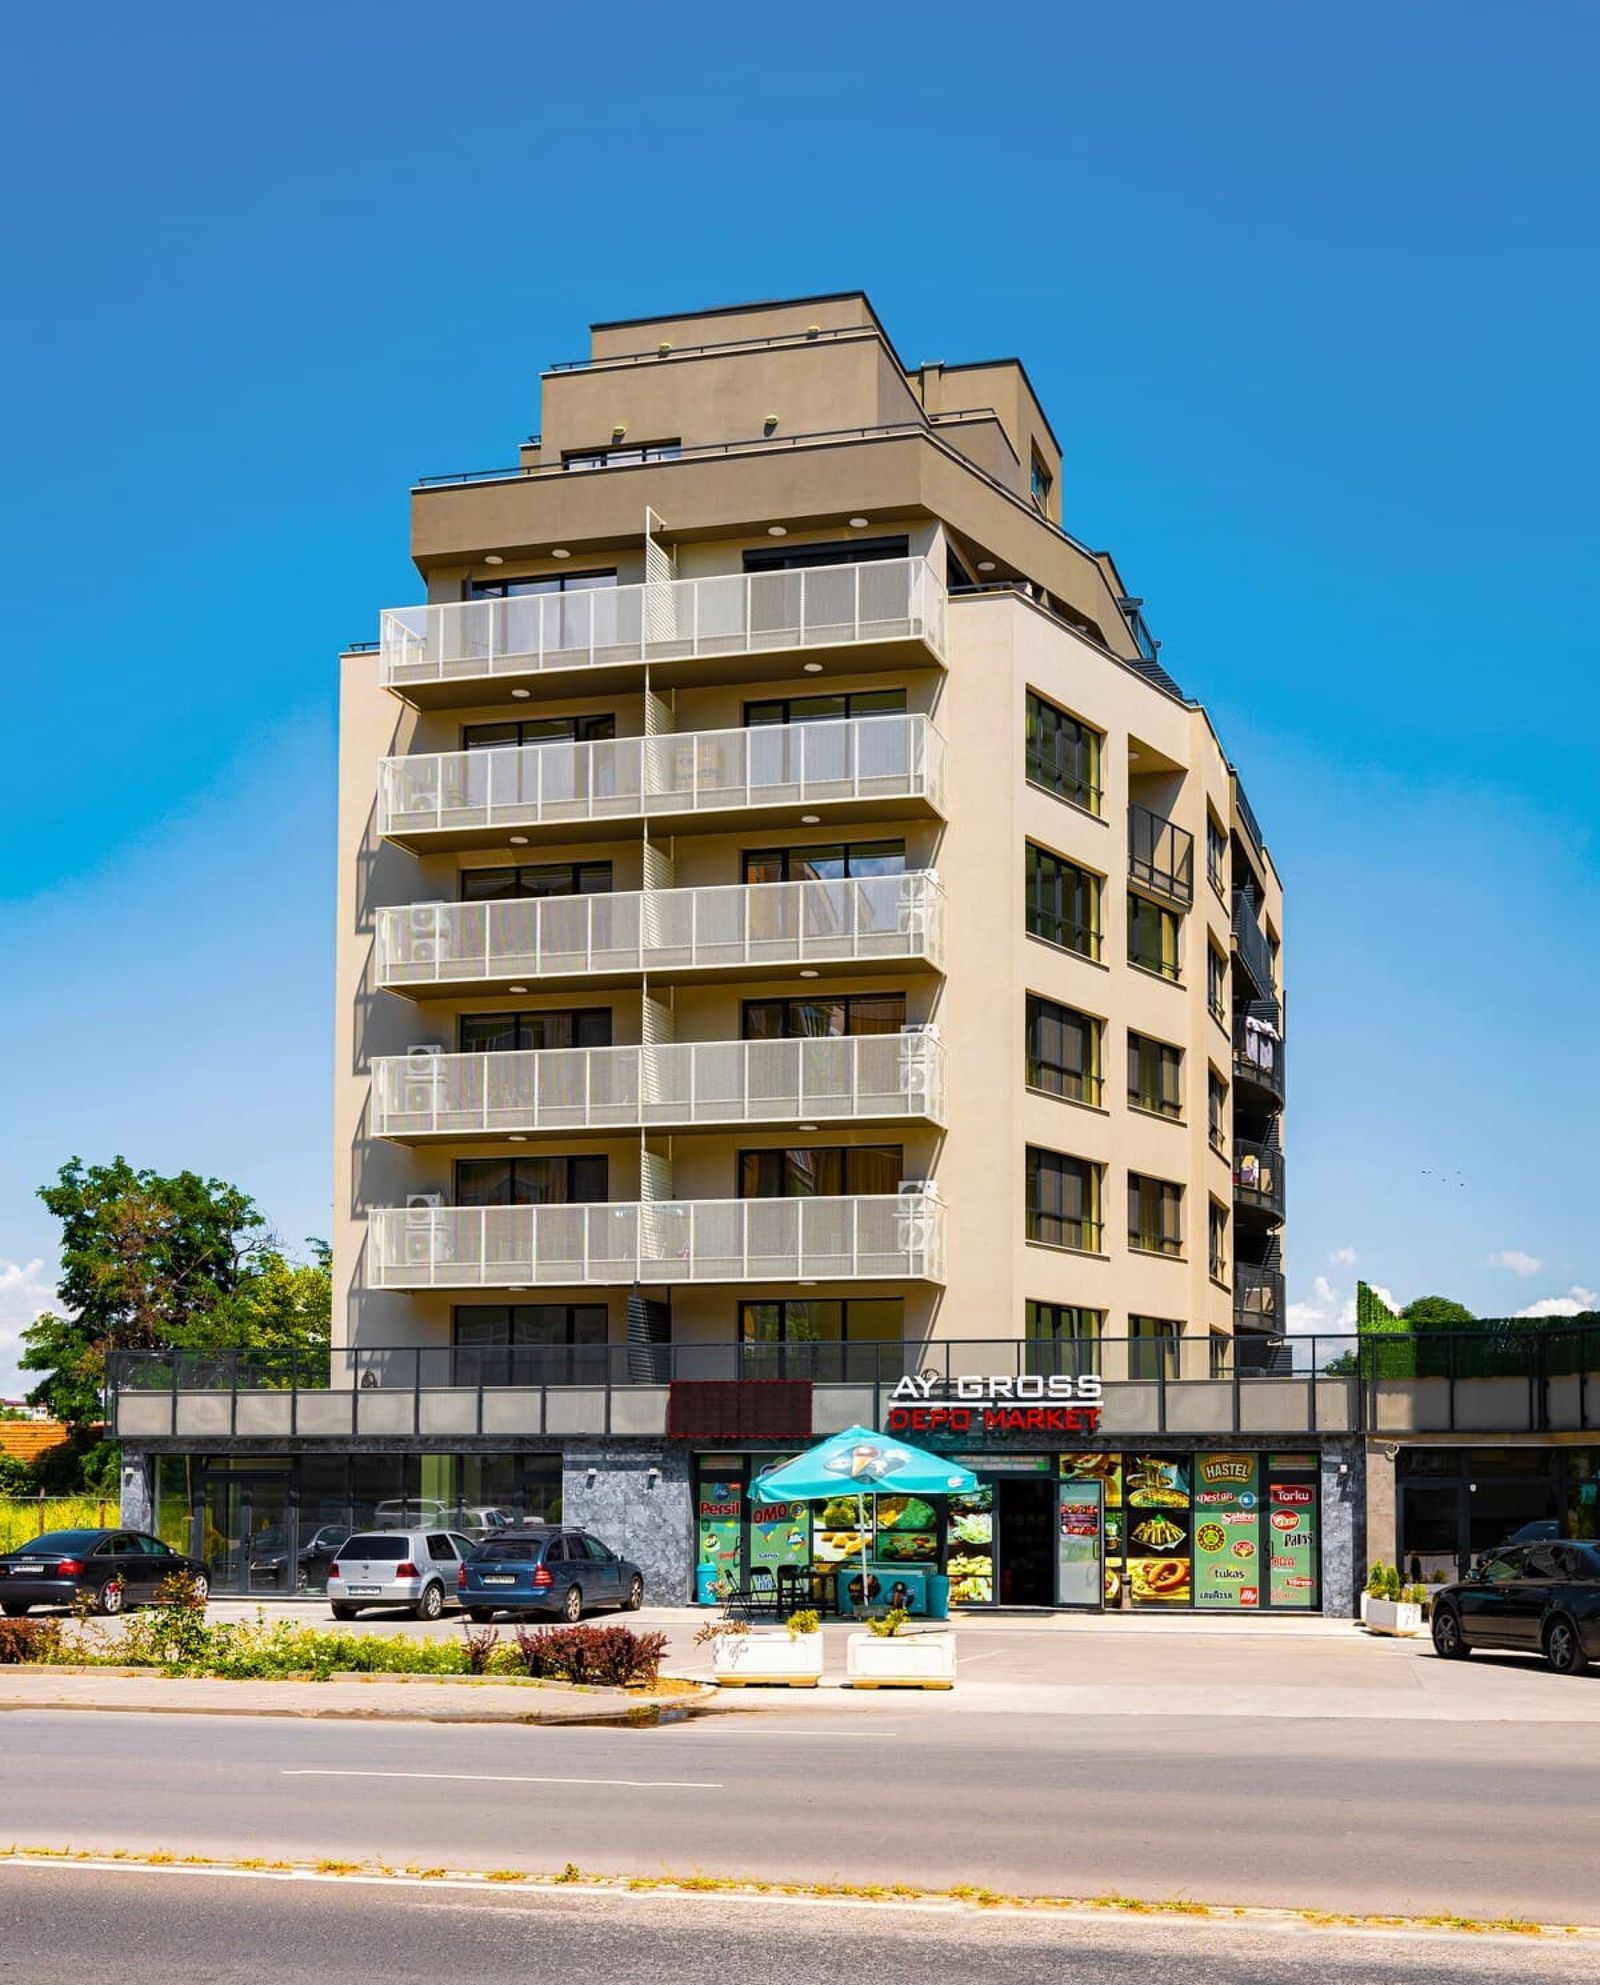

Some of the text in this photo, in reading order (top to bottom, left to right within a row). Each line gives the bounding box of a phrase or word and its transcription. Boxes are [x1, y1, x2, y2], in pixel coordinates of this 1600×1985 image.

[892, 1375, 1102, 1398] AY GROSS
[889, 1408, 1102, 1430] DEPO MARKET
[1205, 1463, 1249, 1478] HASTEL
[1278, 1490, 1309, 1501] Torku
[700, 1502, 740, 1515] Persil
[753, 1503, 788, 1524] OMO
